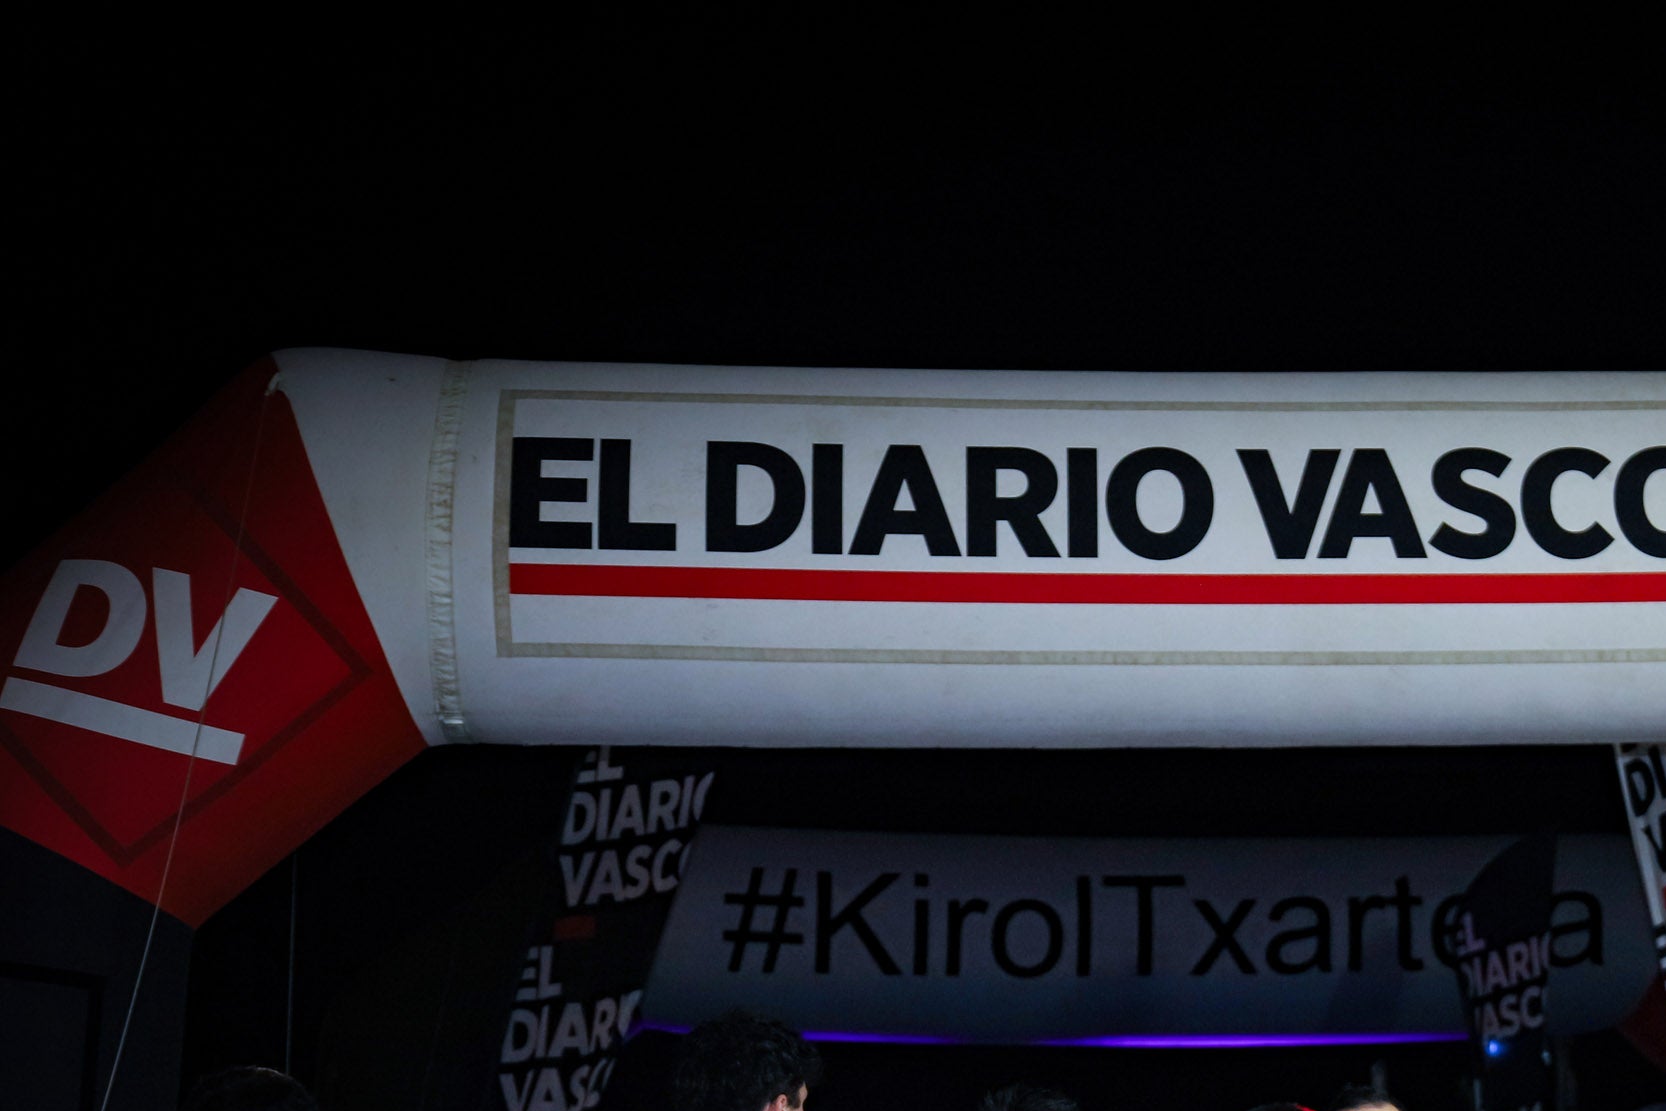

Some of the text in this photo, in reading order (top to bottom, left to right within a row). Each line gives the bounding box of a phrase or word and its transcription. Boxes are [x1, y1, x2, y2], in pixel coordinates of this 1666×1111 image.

[509, 437, 677, 552] EL
[706, 440, 1215, 561] DIARIO
[13, 559, 279, 712] DV
